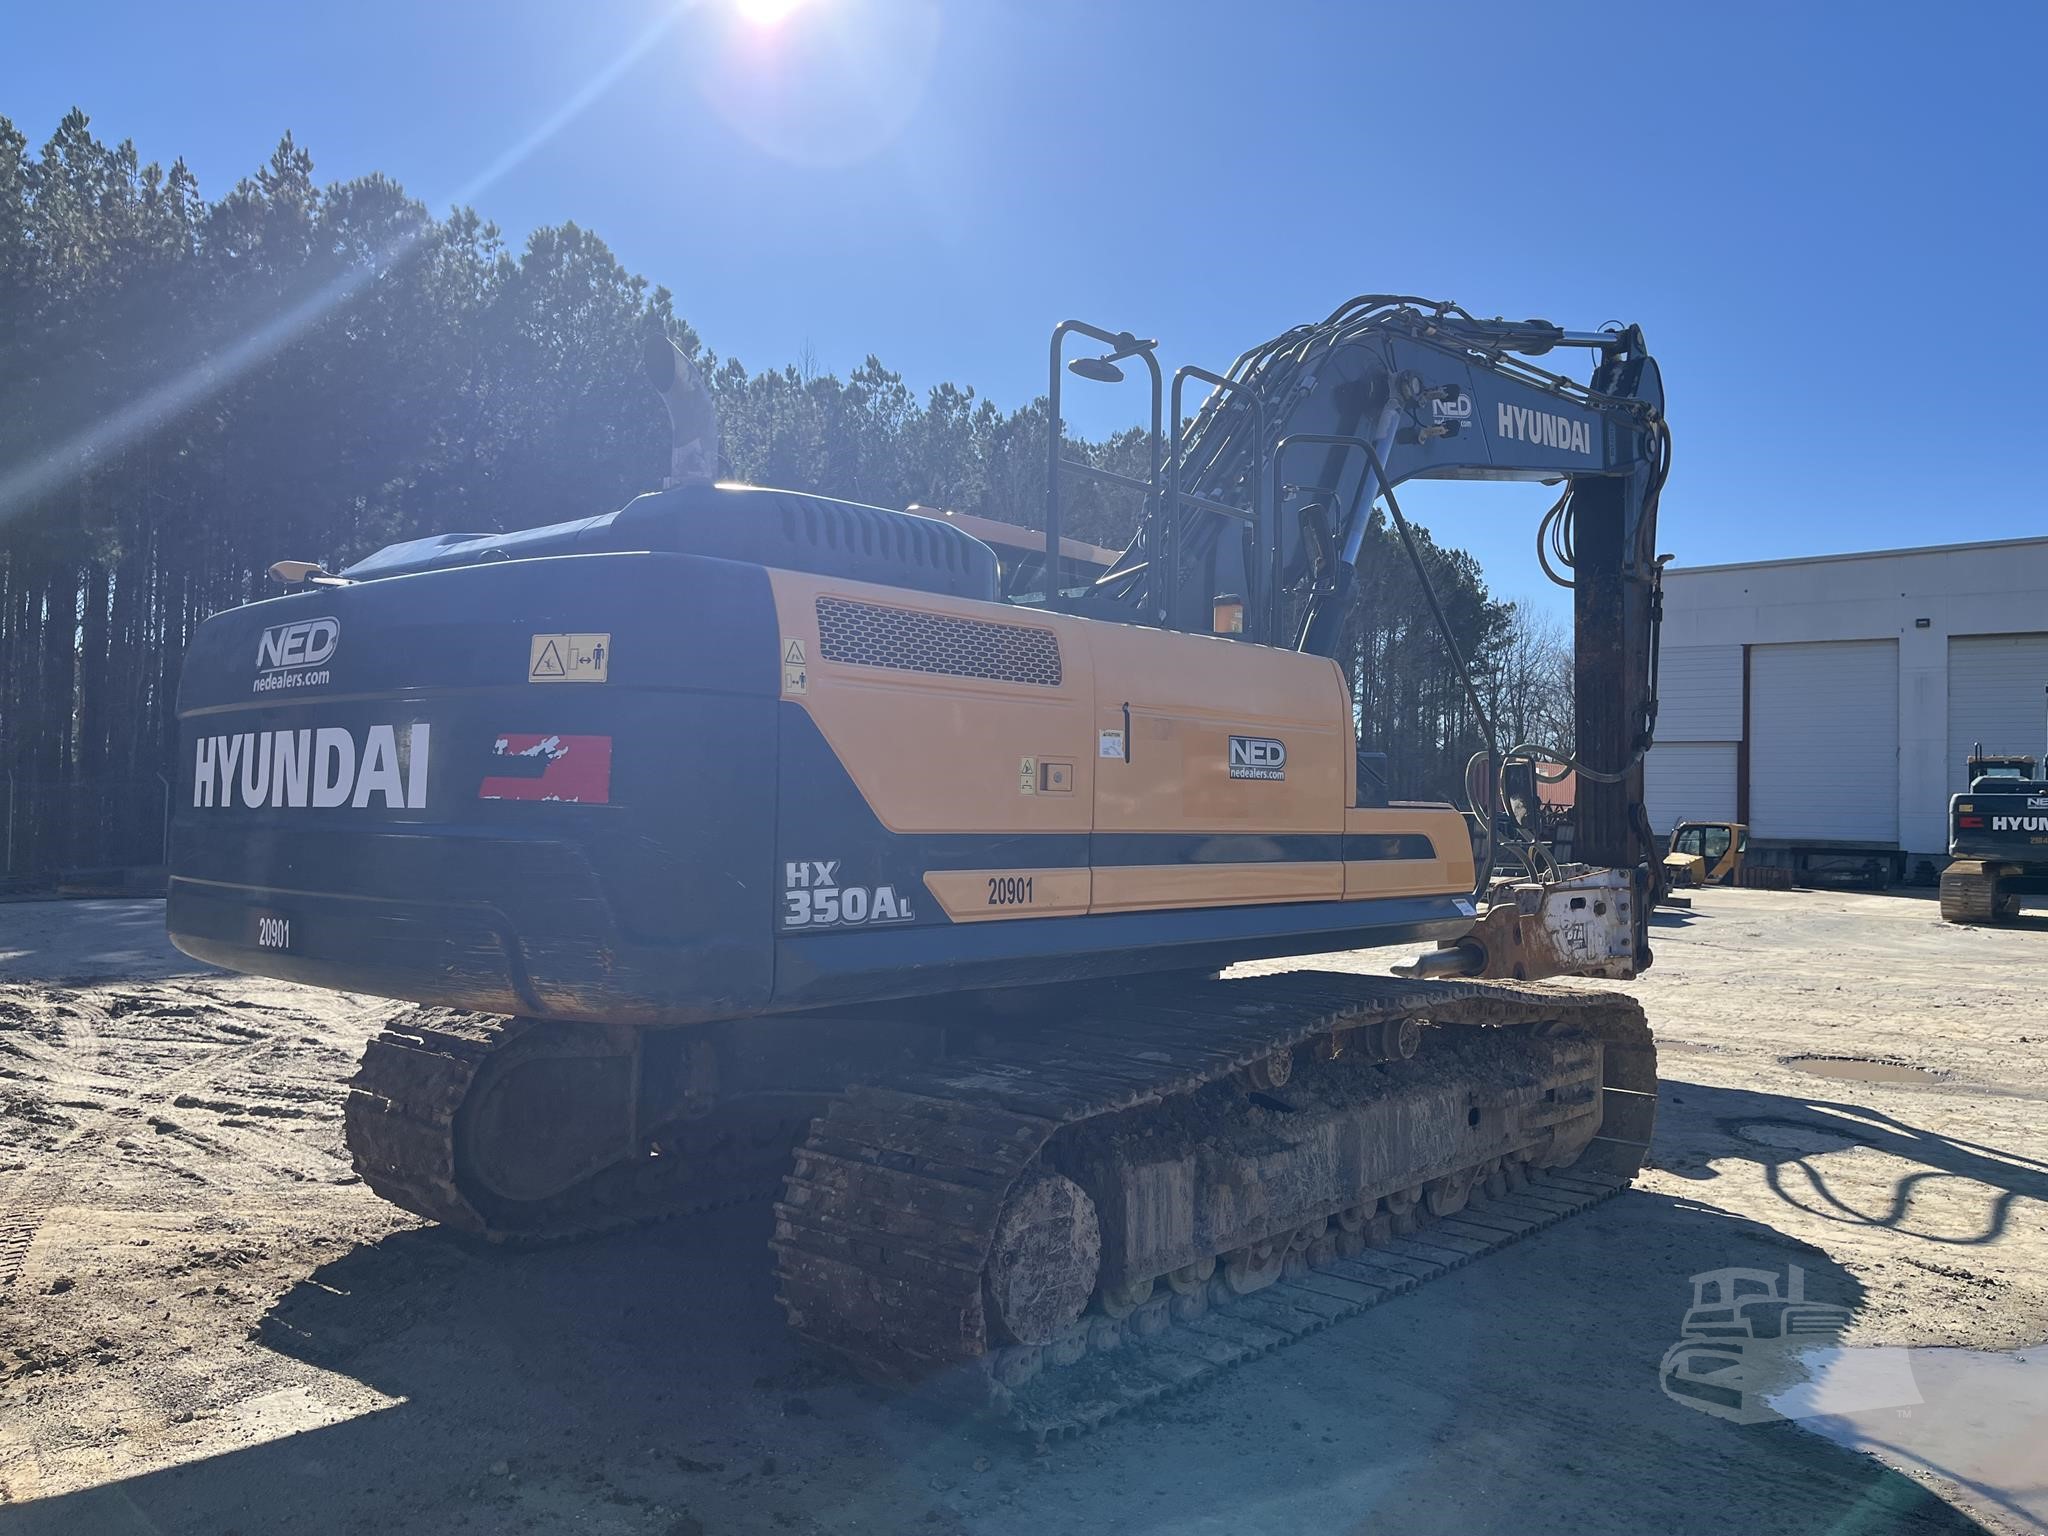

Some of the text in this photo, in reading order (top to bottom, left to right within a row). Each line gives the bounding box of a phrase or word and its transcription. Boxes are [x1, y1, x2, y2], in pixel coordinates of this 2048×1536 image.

[1432, 395, 1471, 416] NED
[1498, 402, 1590, 454] HYUNDAI
[256, 621, 338, 667] NED
[253, 670, 330, 692] nedealers.com
[193, 723, 431, 808] HYUNDAI
[1231, 739, 1284, 766] NED
[1230, 768, 1284, 779] nedealers.com
[785, 861, 837, 888] HX
[988, 876, 1032, 905] 20901
[259, 917, 290, 948] 20901
